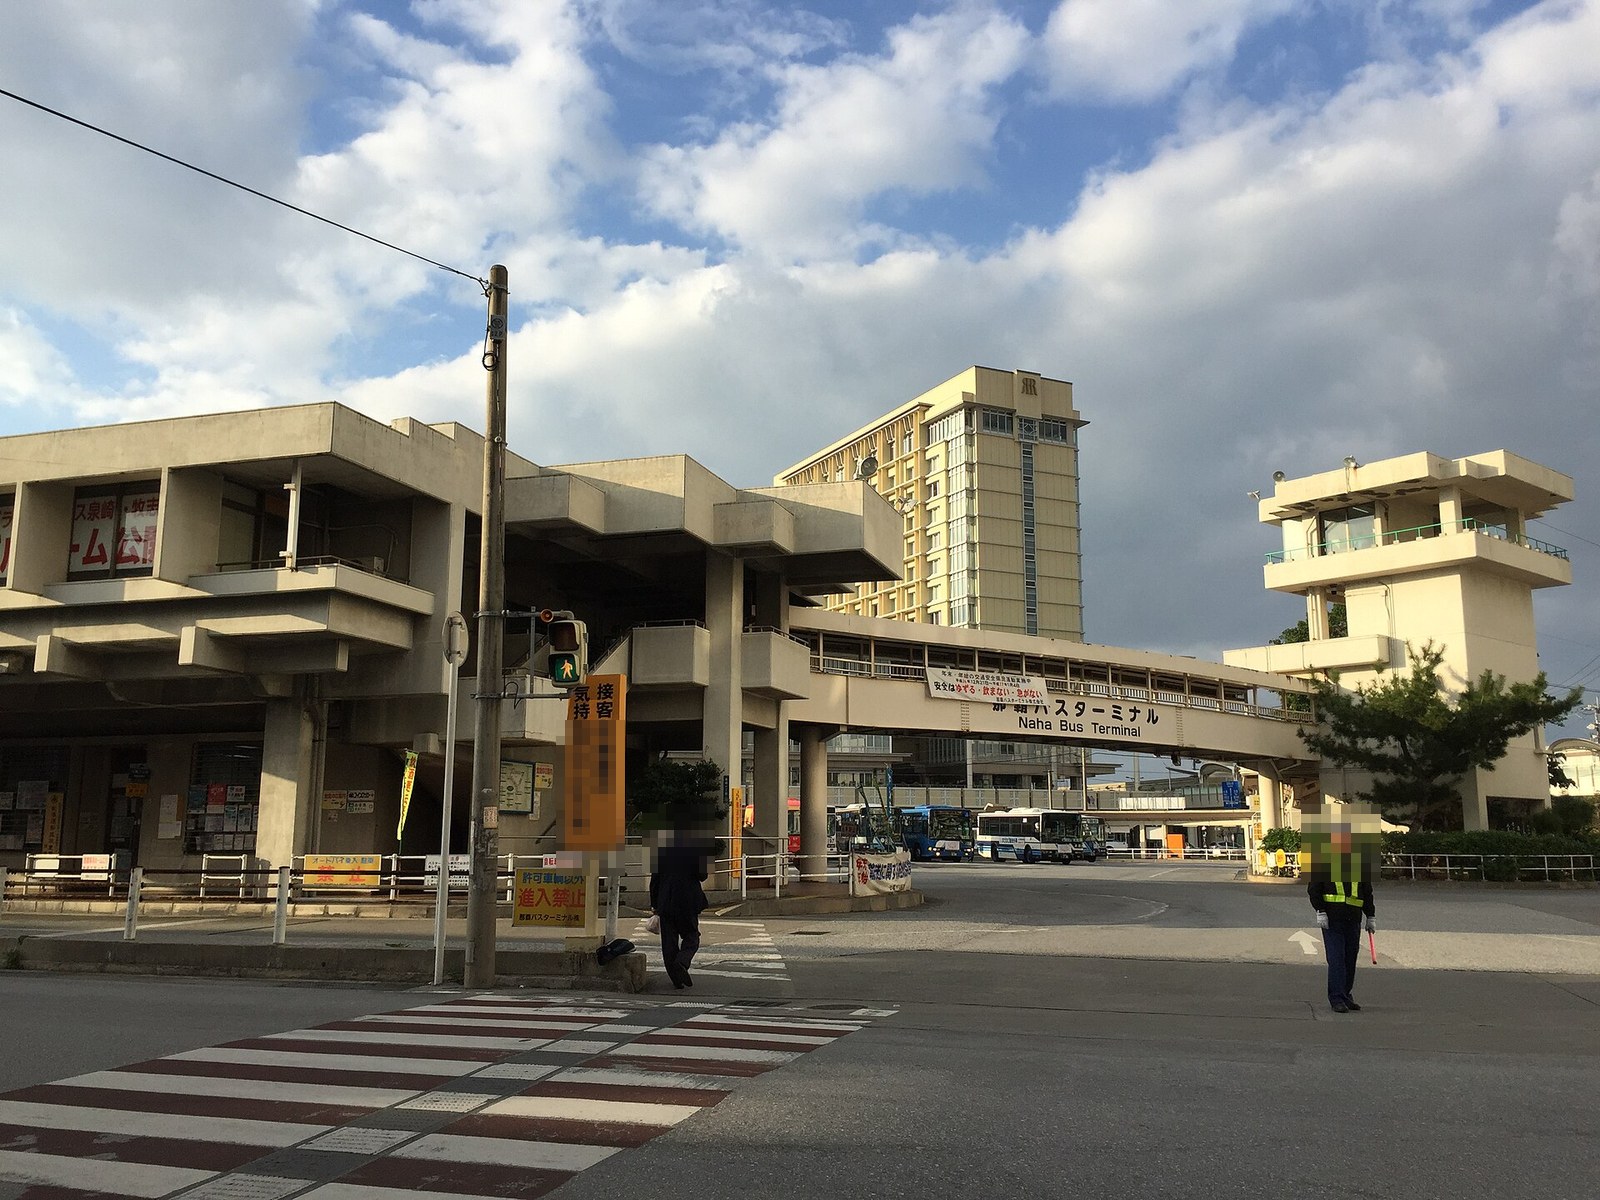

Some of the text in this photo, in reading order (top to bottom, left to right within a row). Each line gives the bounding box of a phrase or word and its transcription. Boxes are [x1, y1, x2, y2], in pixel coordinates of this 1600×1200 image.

[573, 686, 590, 720] 気持
[596, 683, 614, 718] 接客
[1018, 716, 1141, 737] Naha Bus Terminal
[517, 887, 586, 908] 進入禁止
